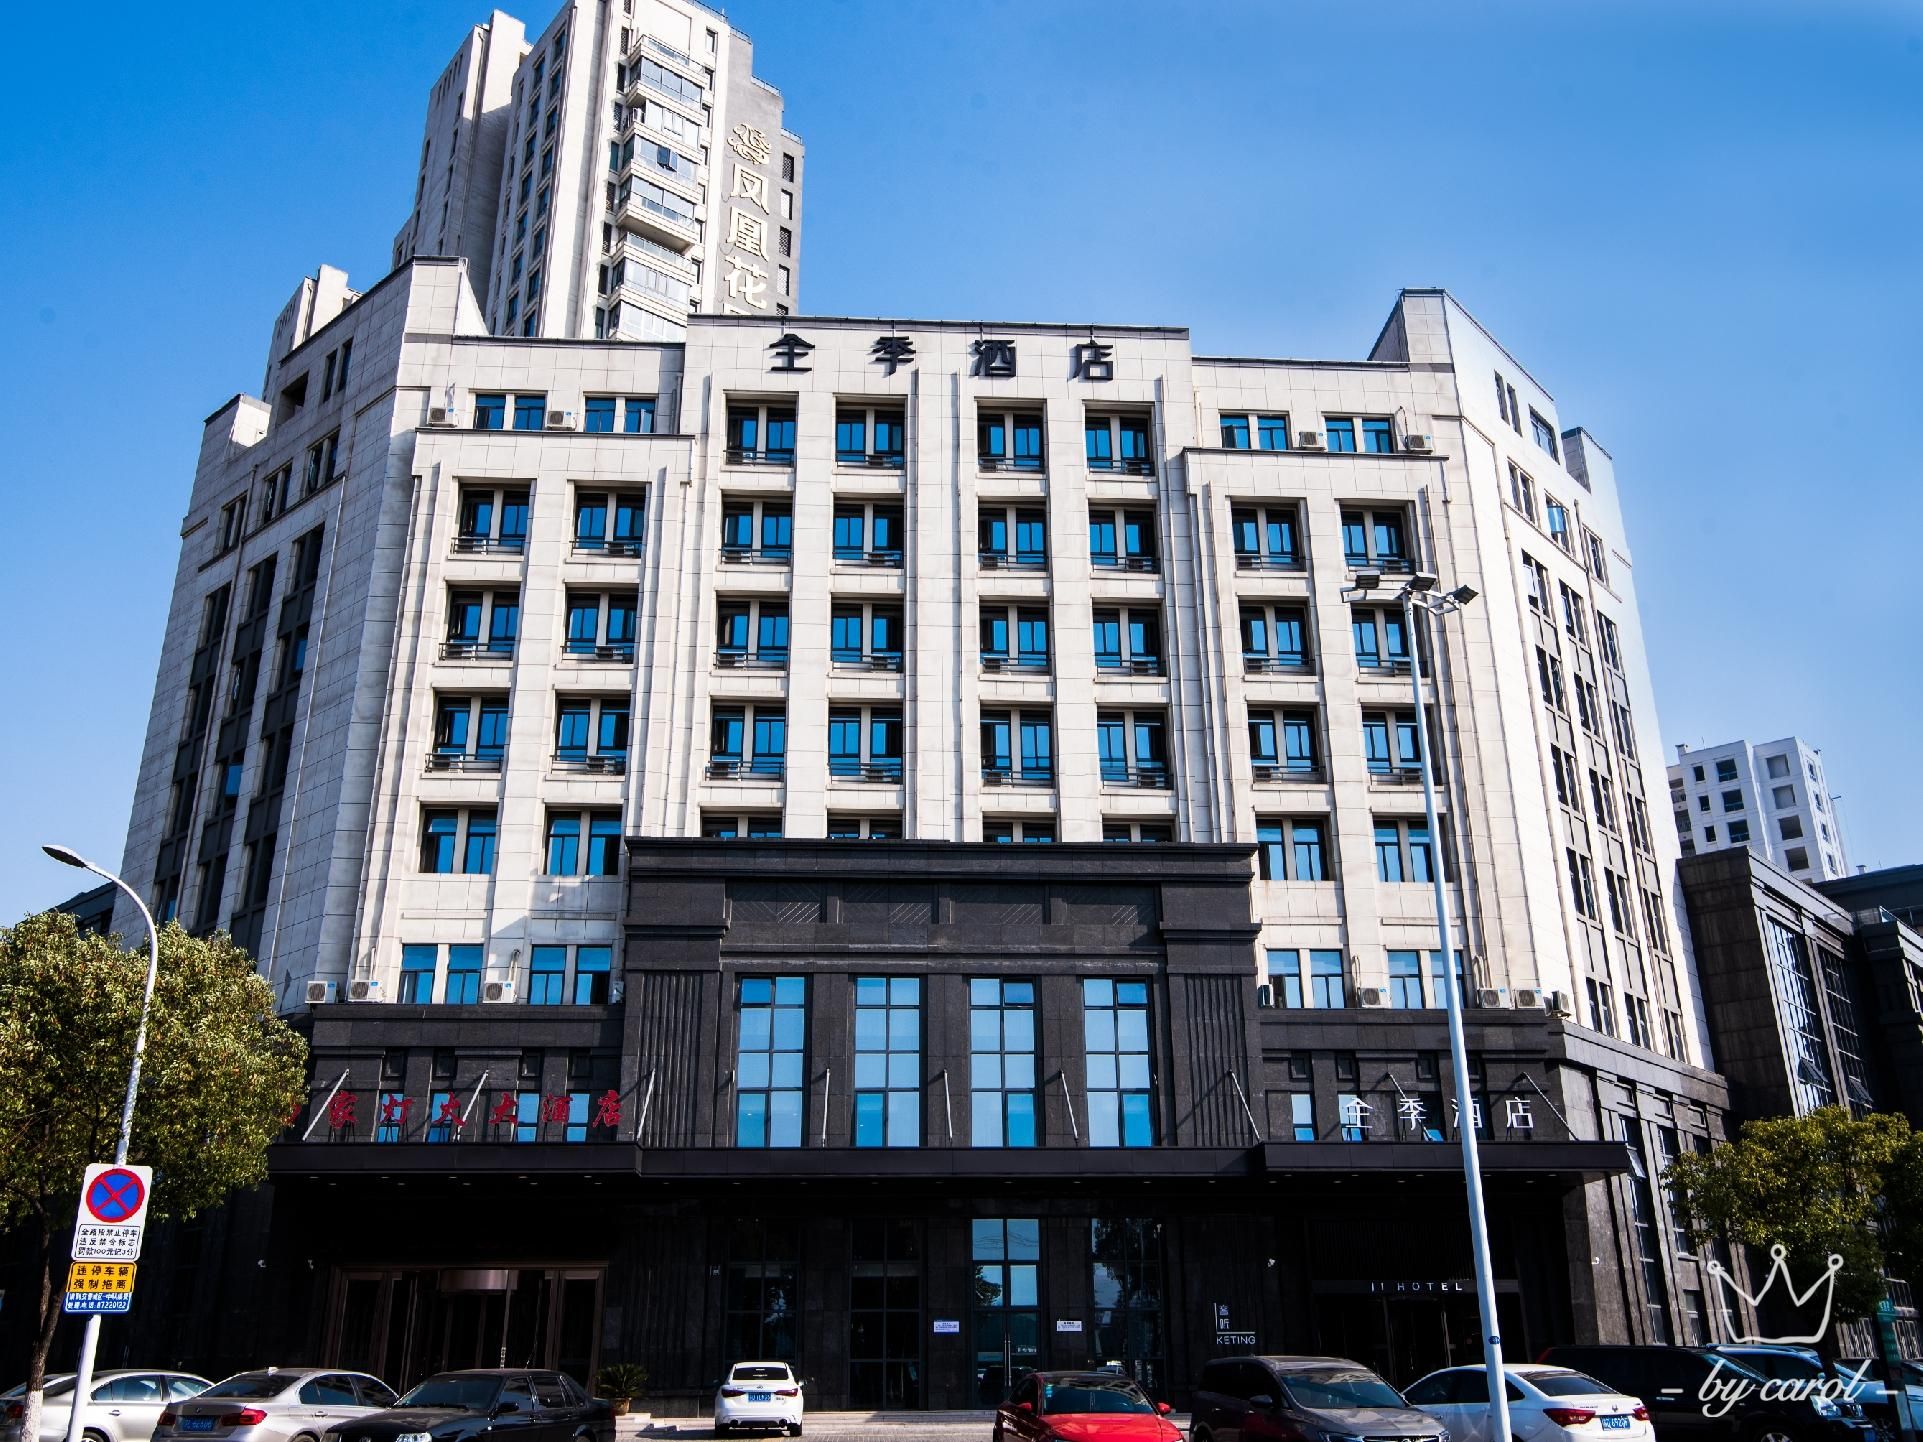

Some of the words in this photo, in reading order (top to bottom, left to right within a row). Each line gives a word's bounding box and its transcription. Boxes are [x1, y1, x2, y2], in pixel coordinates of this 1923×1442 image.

[768, 333, 1114, 381] 全季酒店
[81, 1228, 137, 1237] 全路段禁止停车
[79, 1238, 135, 1246] 违反禁令标志
[76, 1266, 129, 1276] 违停车辆
[74, 1279, 127, 1290] 强制拖离
[1397, 1282, 1463, 1291] HOTEL
[1216, 1335, 1256, 1345] KETING
